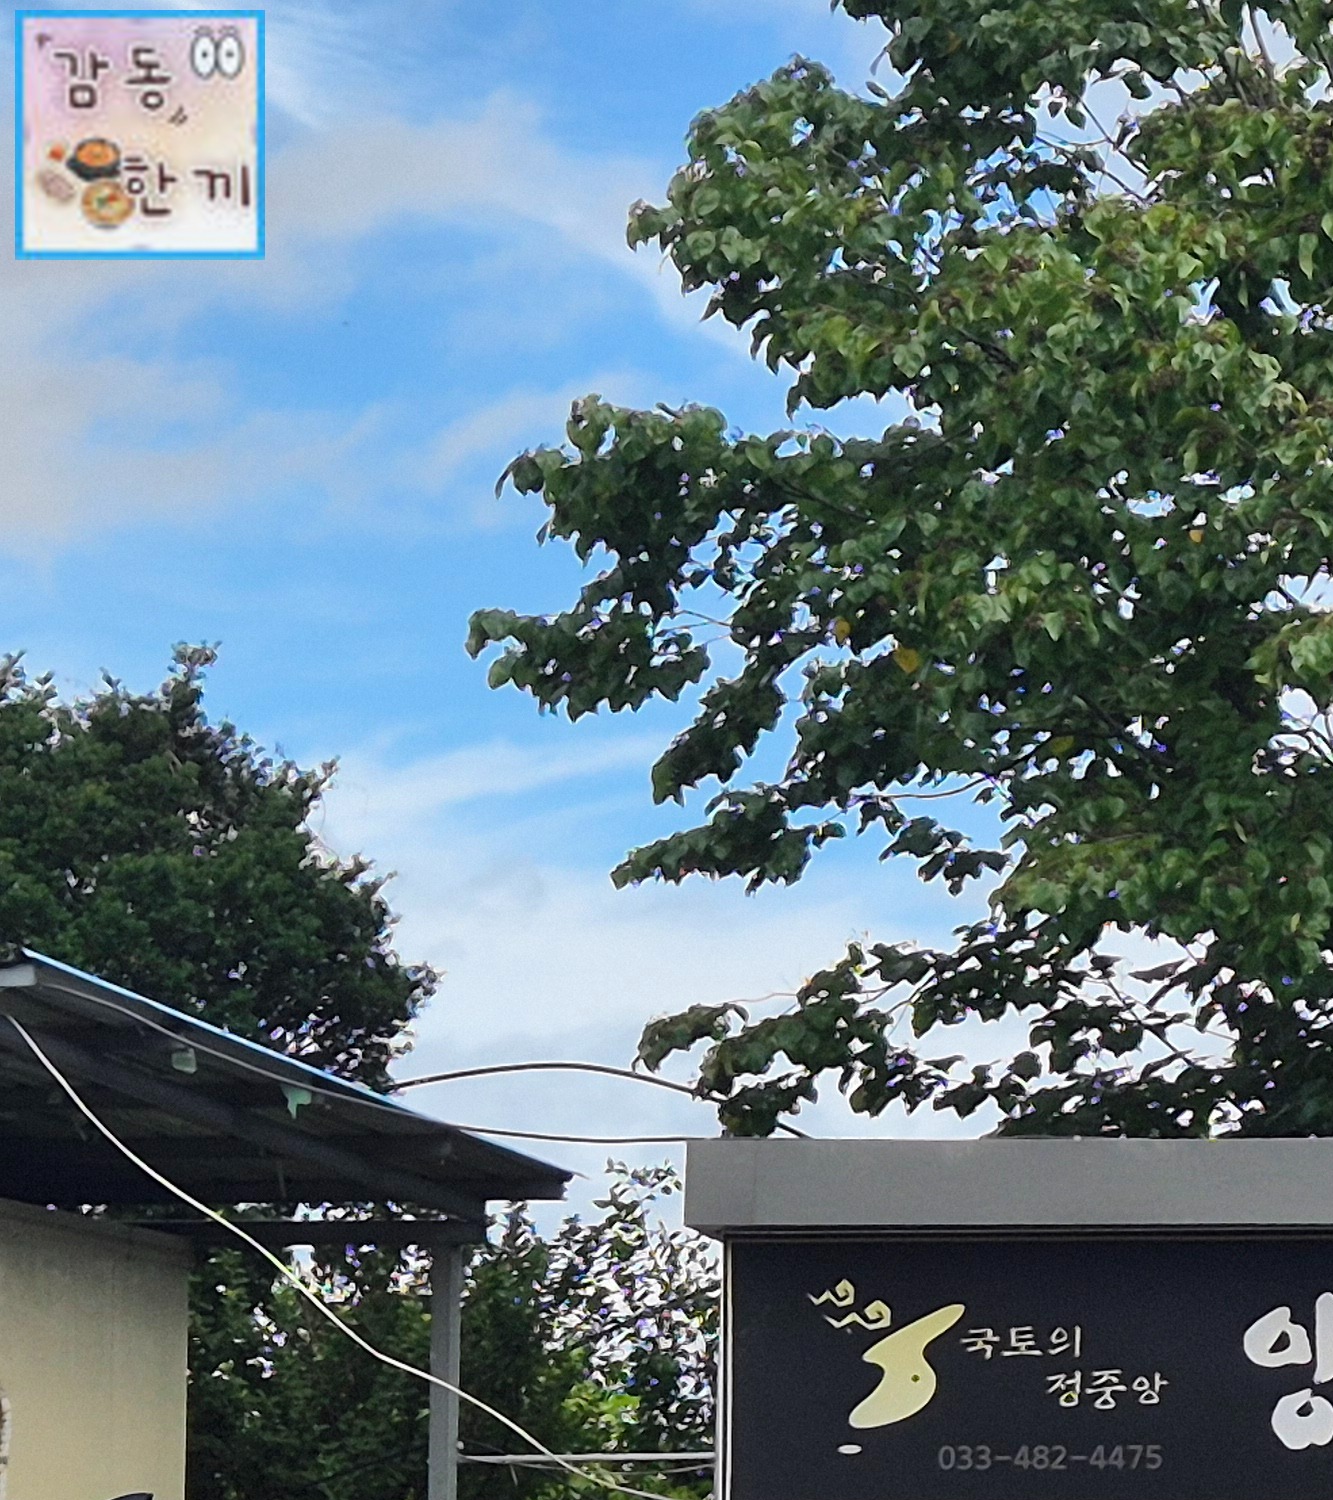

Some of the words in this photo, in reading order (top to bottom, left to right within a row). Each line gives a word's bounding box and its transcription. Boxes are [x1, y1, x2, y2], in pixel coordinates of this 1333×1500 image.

[959, 1325, 1083, 1360] 국토의
[1045, 1369, 1169, 1410] 정중앙
[938, 1444, 1164, 1471] 033-482-4475
